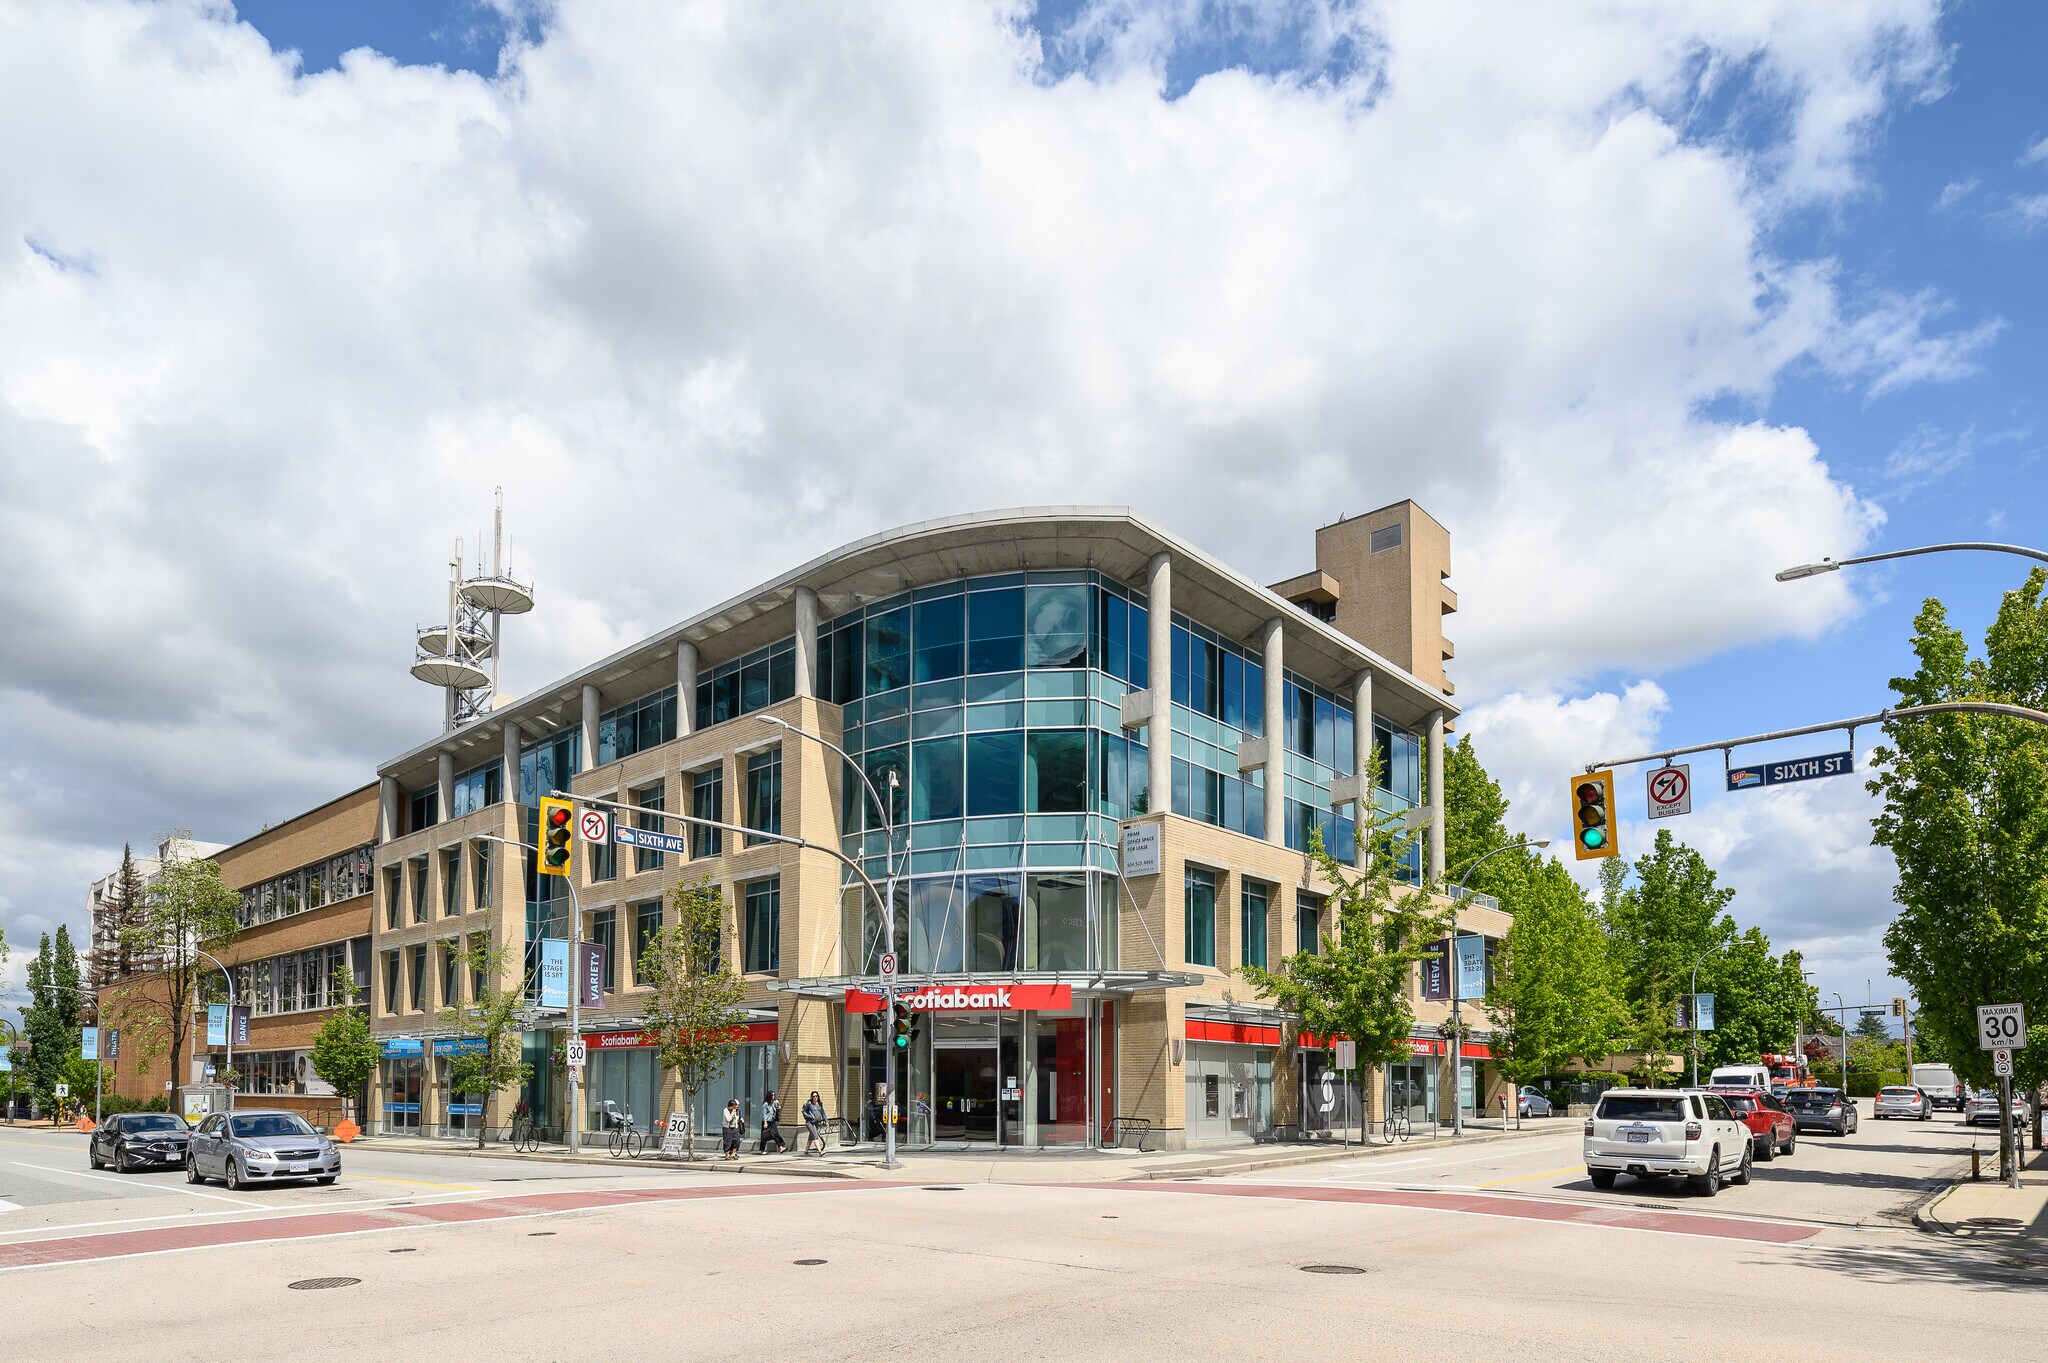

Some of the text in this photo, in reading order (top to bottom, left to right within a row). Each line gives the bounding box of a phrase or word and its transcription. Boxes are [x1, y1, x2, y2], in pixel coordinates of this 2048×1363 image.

[1774, 756, 1844, 780] SIXTH ST
[1734, 771, 1744, 780] UP
[1656, 802, 1682, 811] EXCEPT
[1658, 808, 1680, 816] BUSES
[638, 834, 663, 848] SIXTH
[665, 838, 683, 850] AVE
[590, 952, 600, 1001] VARIETY
[1982, 1007, 2019, 1016] MAXIMUM
[239, 1016, 247, 1041] DANCE
[1985, 1015, 2019, 1039] 30
[601, 1034, 640, 1047] Scotiabank
[1991, 1038, 2014, 1046] km/h
[570, 1046, 584, 1059] 30
[669, 1119, 687, 1132] 30
